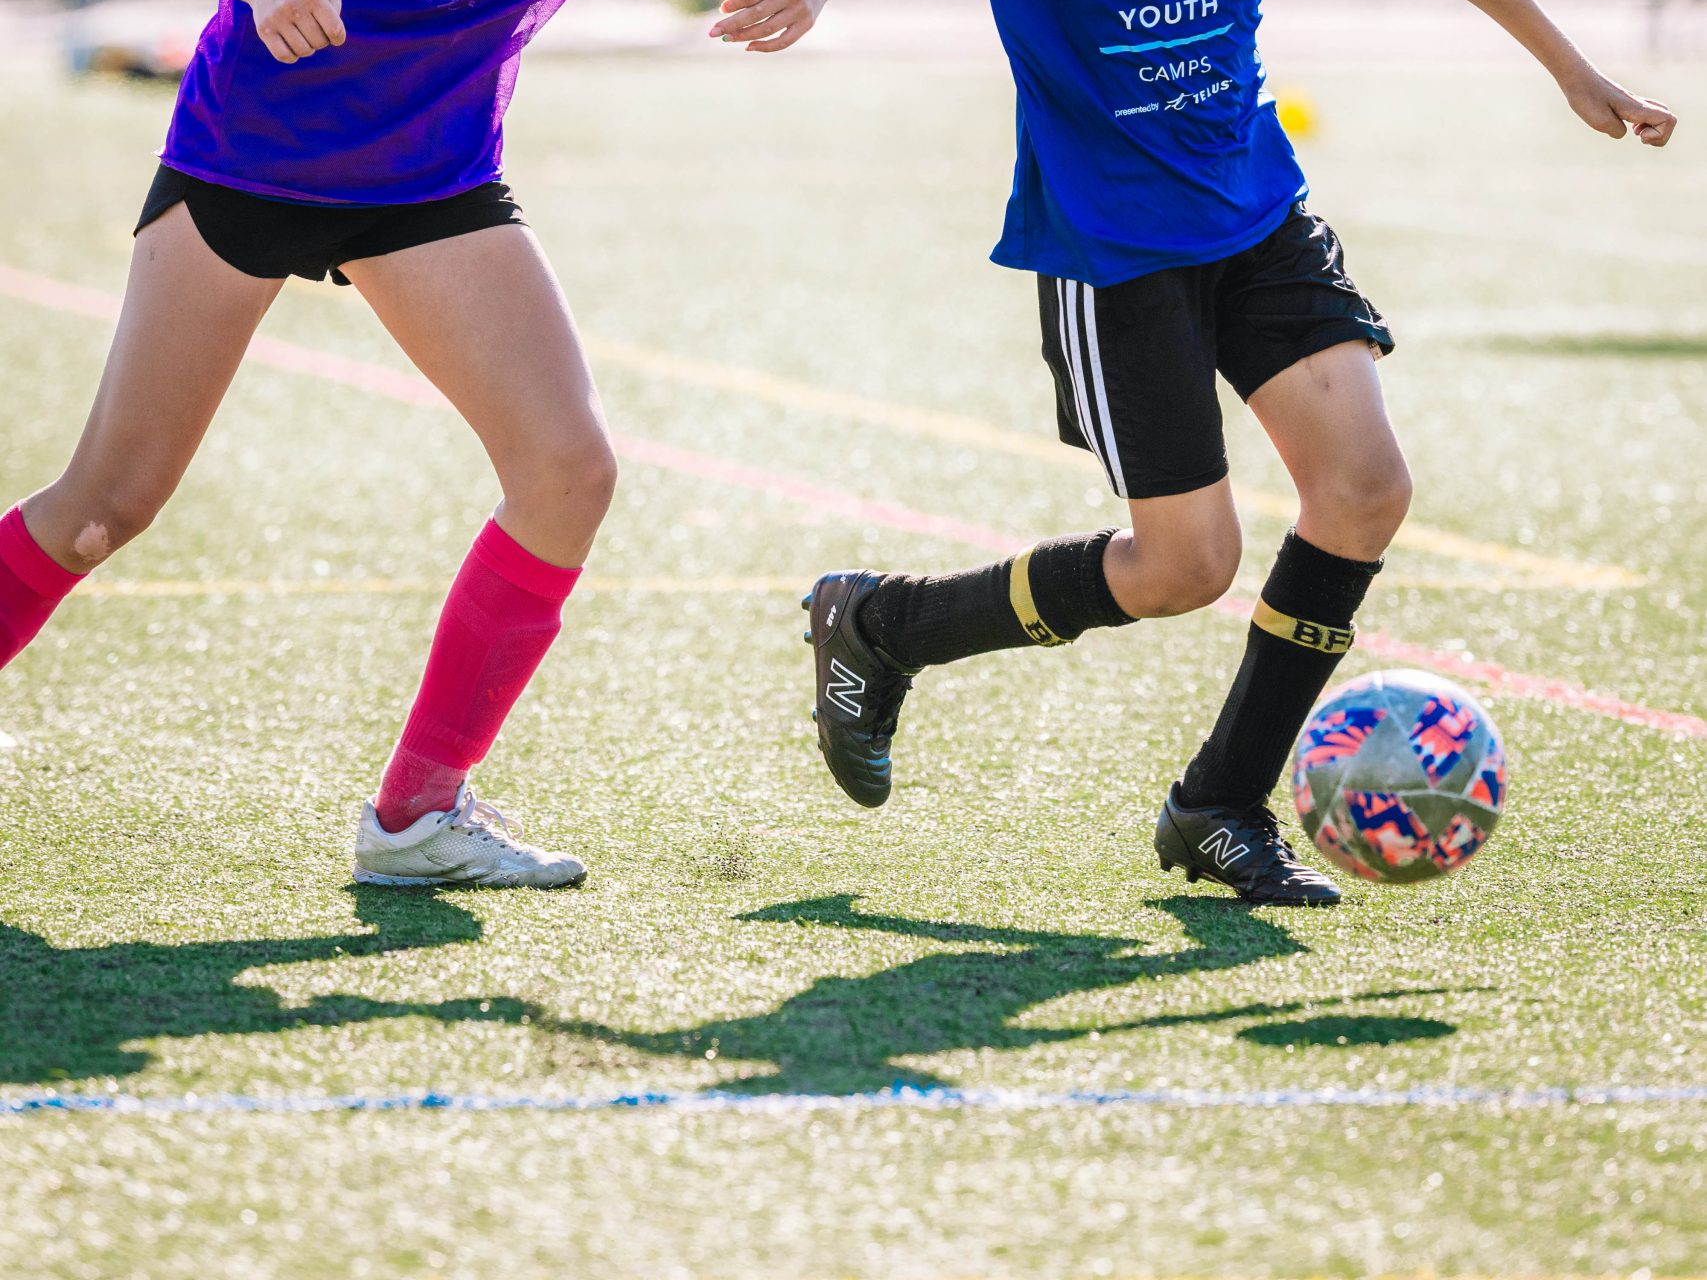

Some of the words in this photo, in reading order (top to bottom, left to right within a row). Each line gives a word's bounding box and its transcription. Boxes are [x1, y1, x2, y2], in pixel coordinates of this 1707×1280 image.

[1139, 55, 1212, 82] CAMPS
[1114, 104, 1151, 118] presented
[1150, 102, 1159, 112] by
[1193, 80, 1230, 104] TELUS
[1293, 619, 1354, 651] BF
[825, 657, 866, 718] N
[1198, 827, 1250, 870] N
